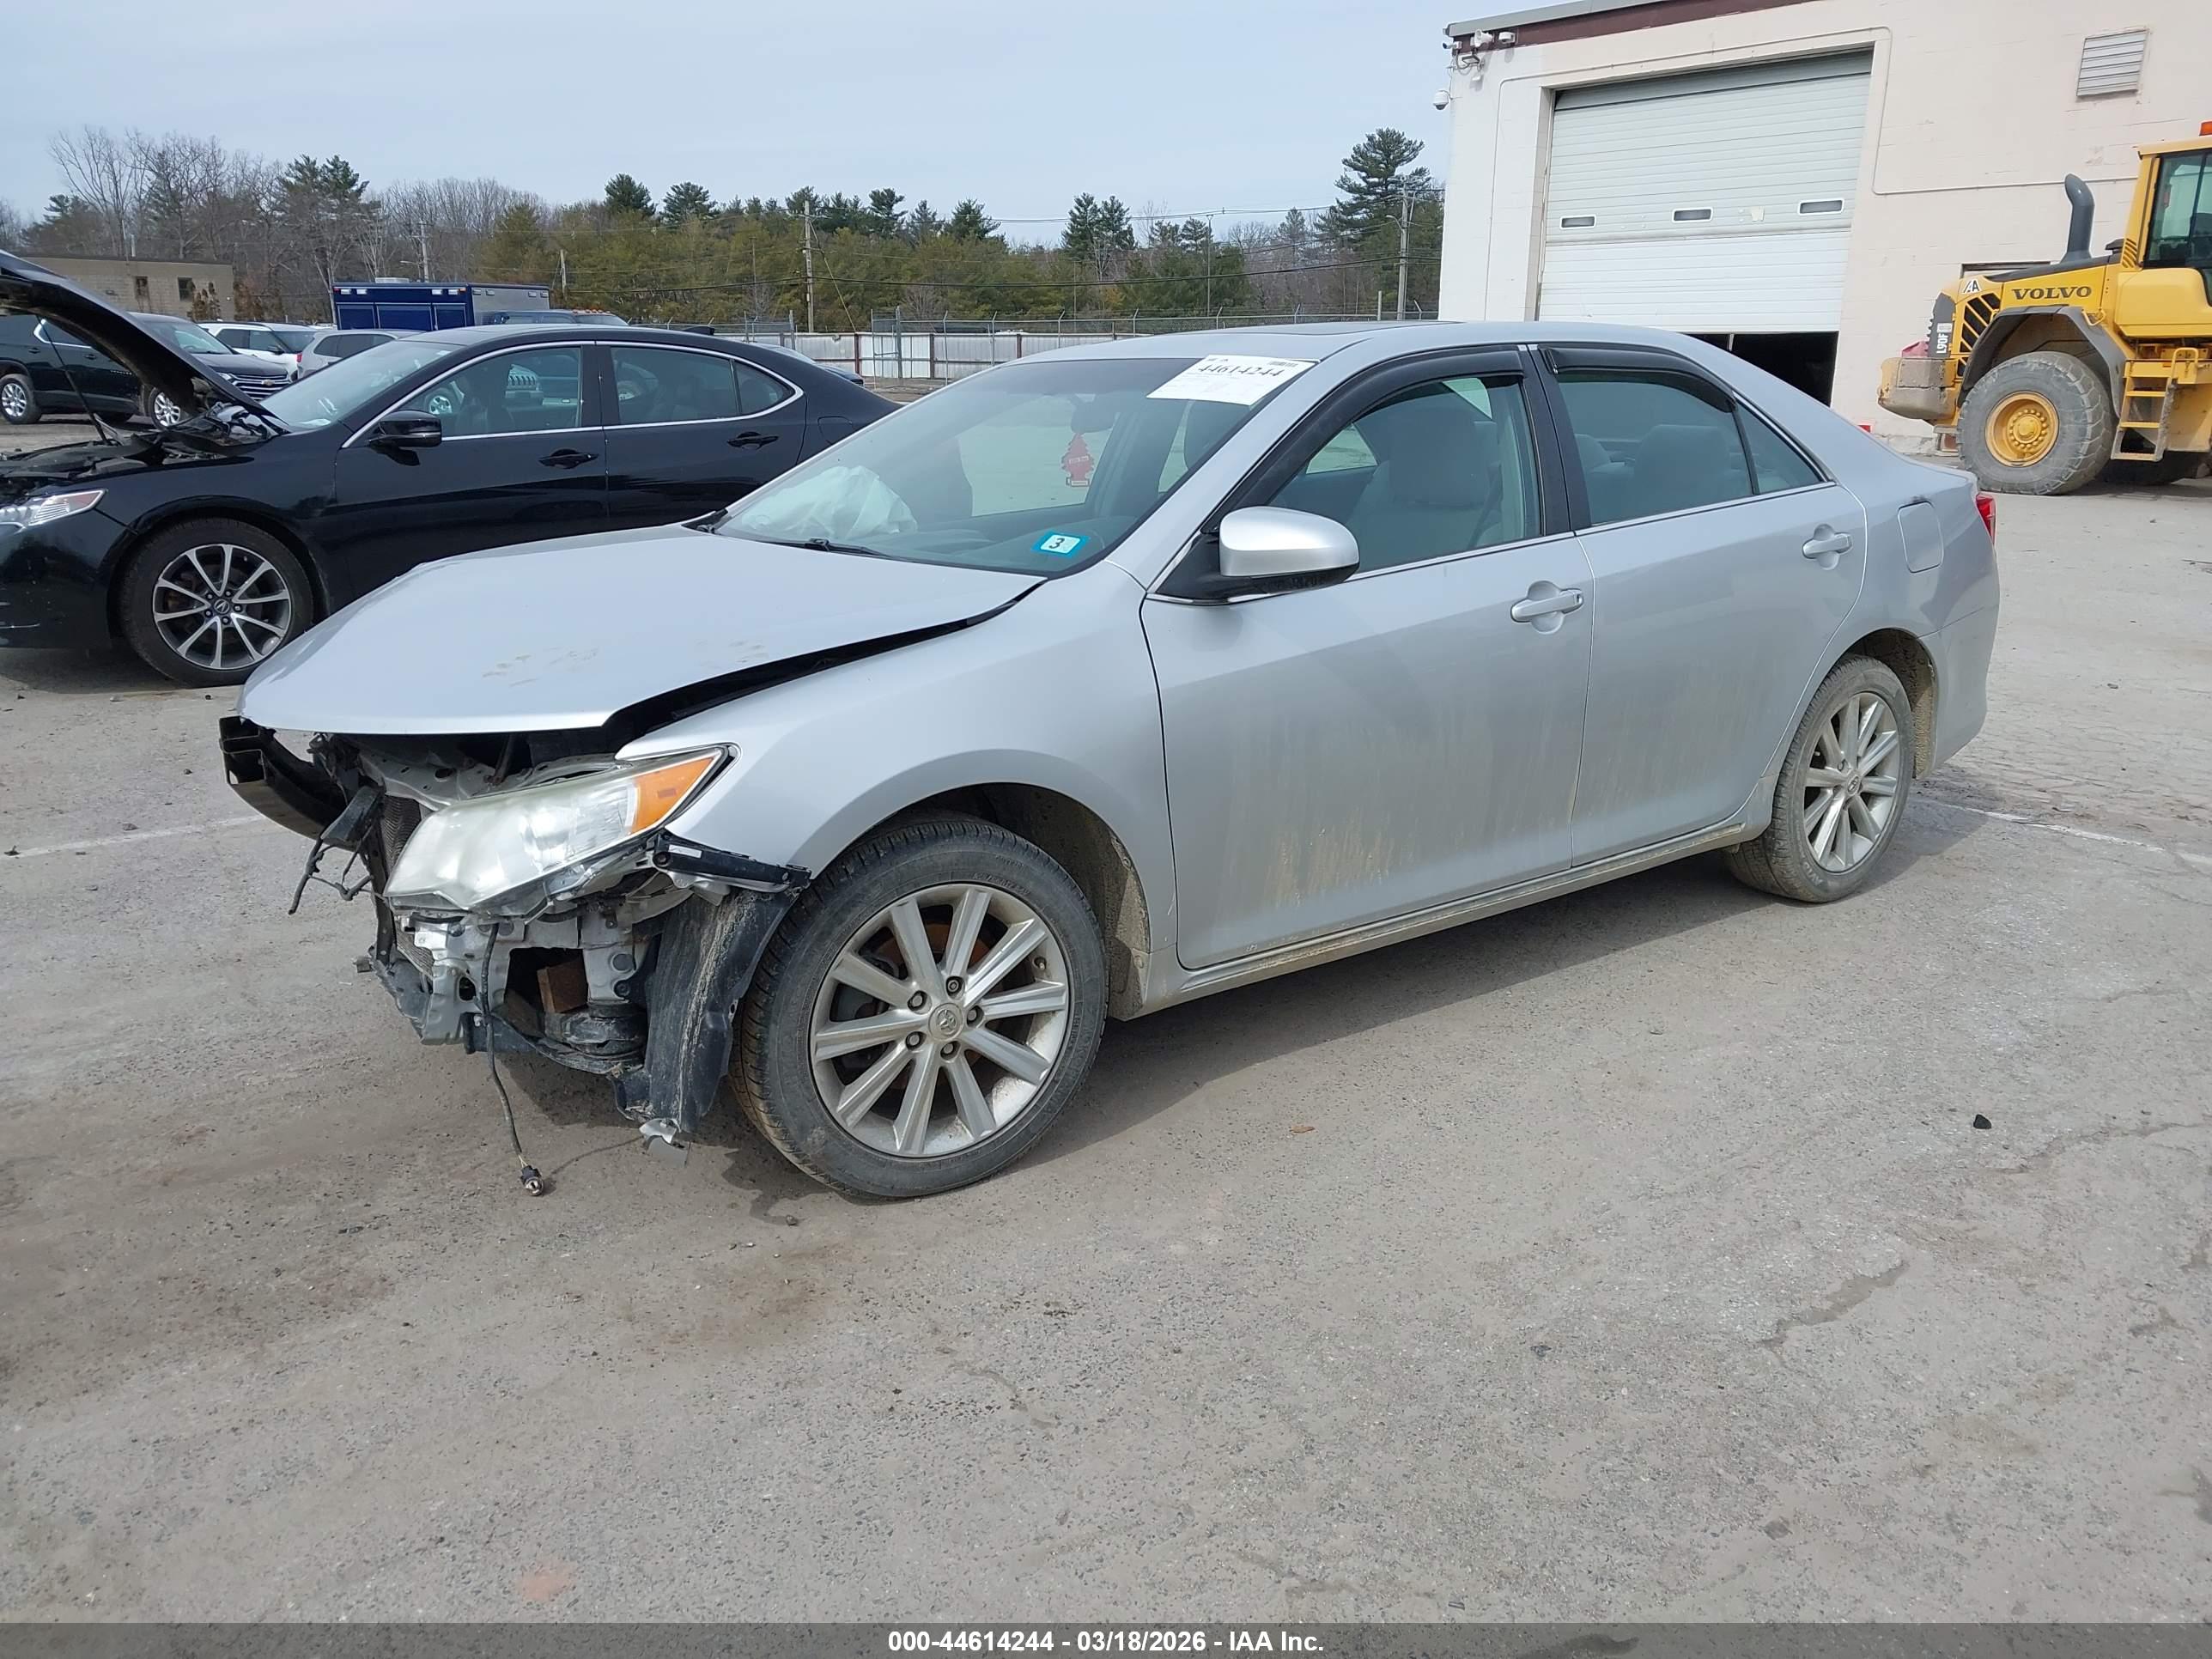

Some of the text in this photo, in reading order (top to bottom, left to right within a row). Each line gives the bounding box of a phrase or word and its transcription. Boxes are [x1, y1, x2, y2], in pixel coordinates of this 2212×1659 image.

[2011, 285, 2093, 301] VOLVO
[1936, 333, 1949, 354] L90F
[1048, 538, 1066, 550] 3
